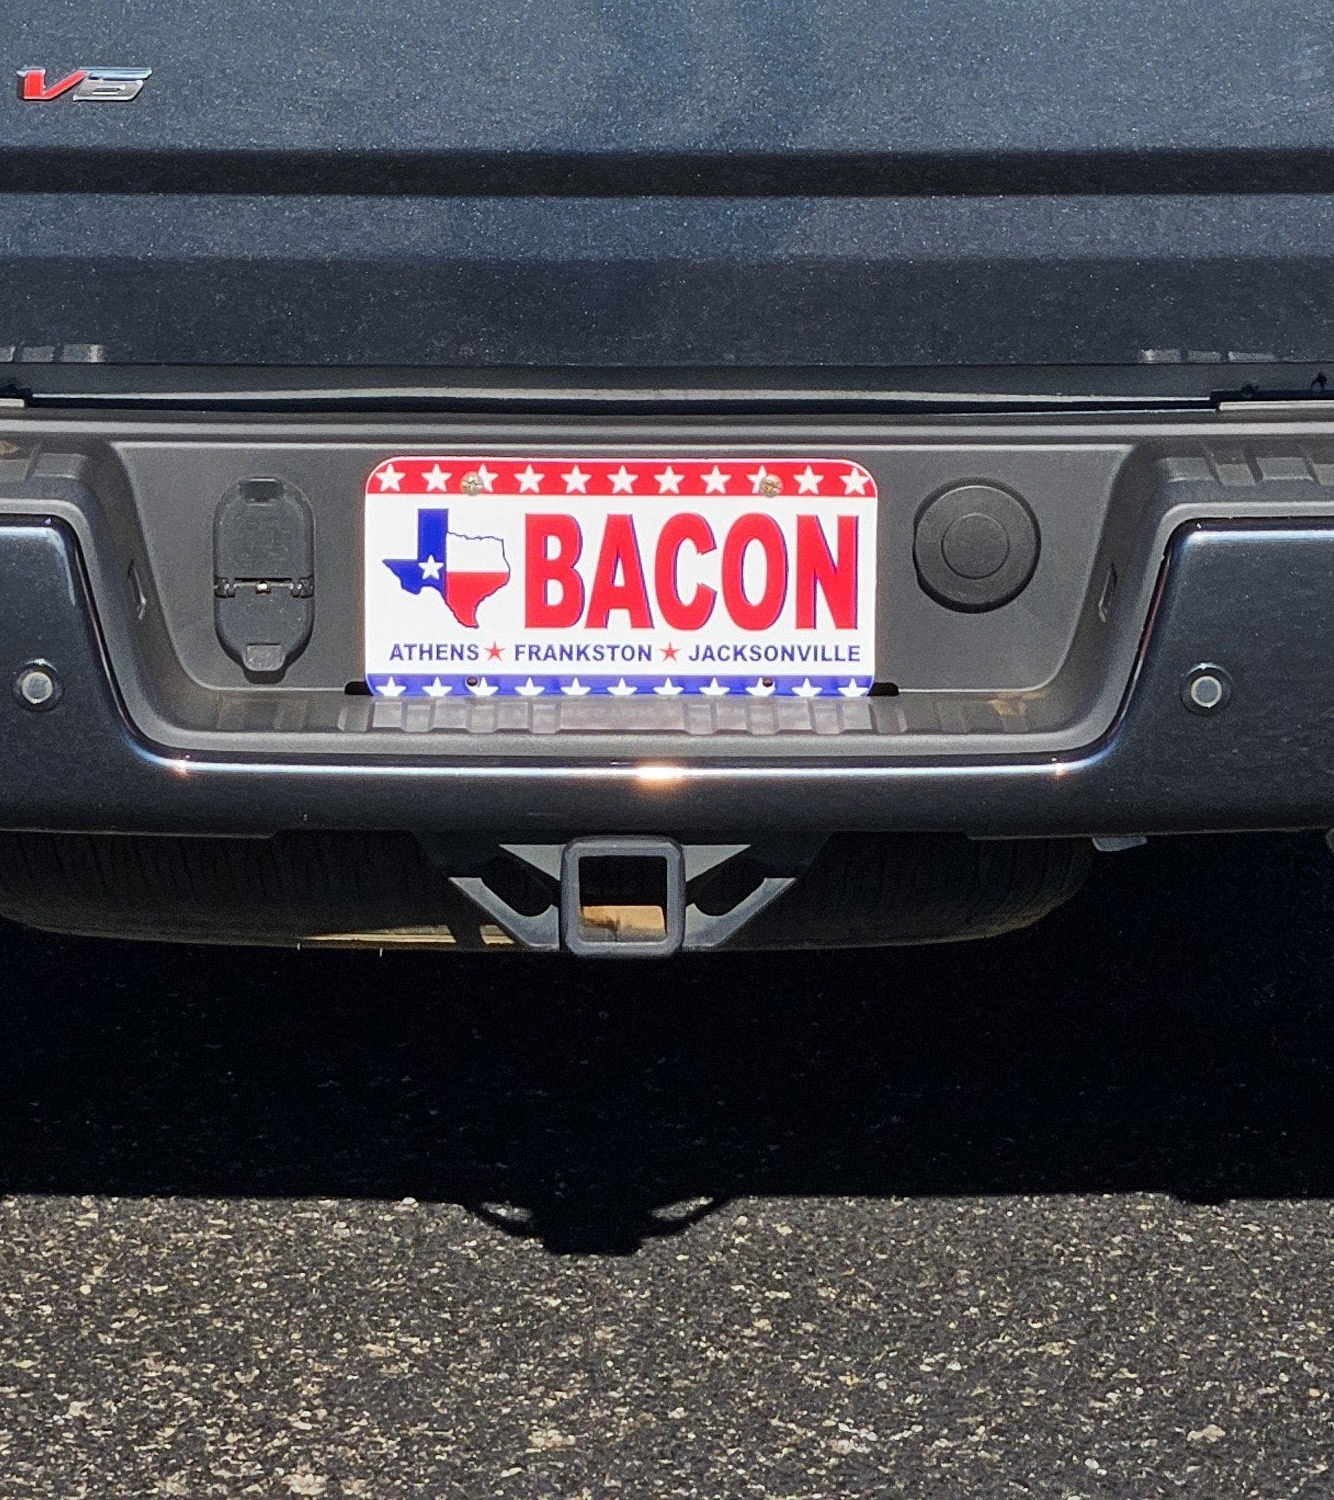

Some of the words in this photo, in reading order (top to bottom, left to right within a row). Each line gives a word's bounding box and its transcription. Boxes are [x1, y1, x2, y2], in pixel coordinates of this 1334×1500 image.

[17, 66, 153, 102] V6
[524, 511, 860, 631] BACON
[389, 642, 480, 662] ATHENS
[514, 643, 652, 662] FRANKSTON
[688, 643, 861, 663] JACKSONVILLE
